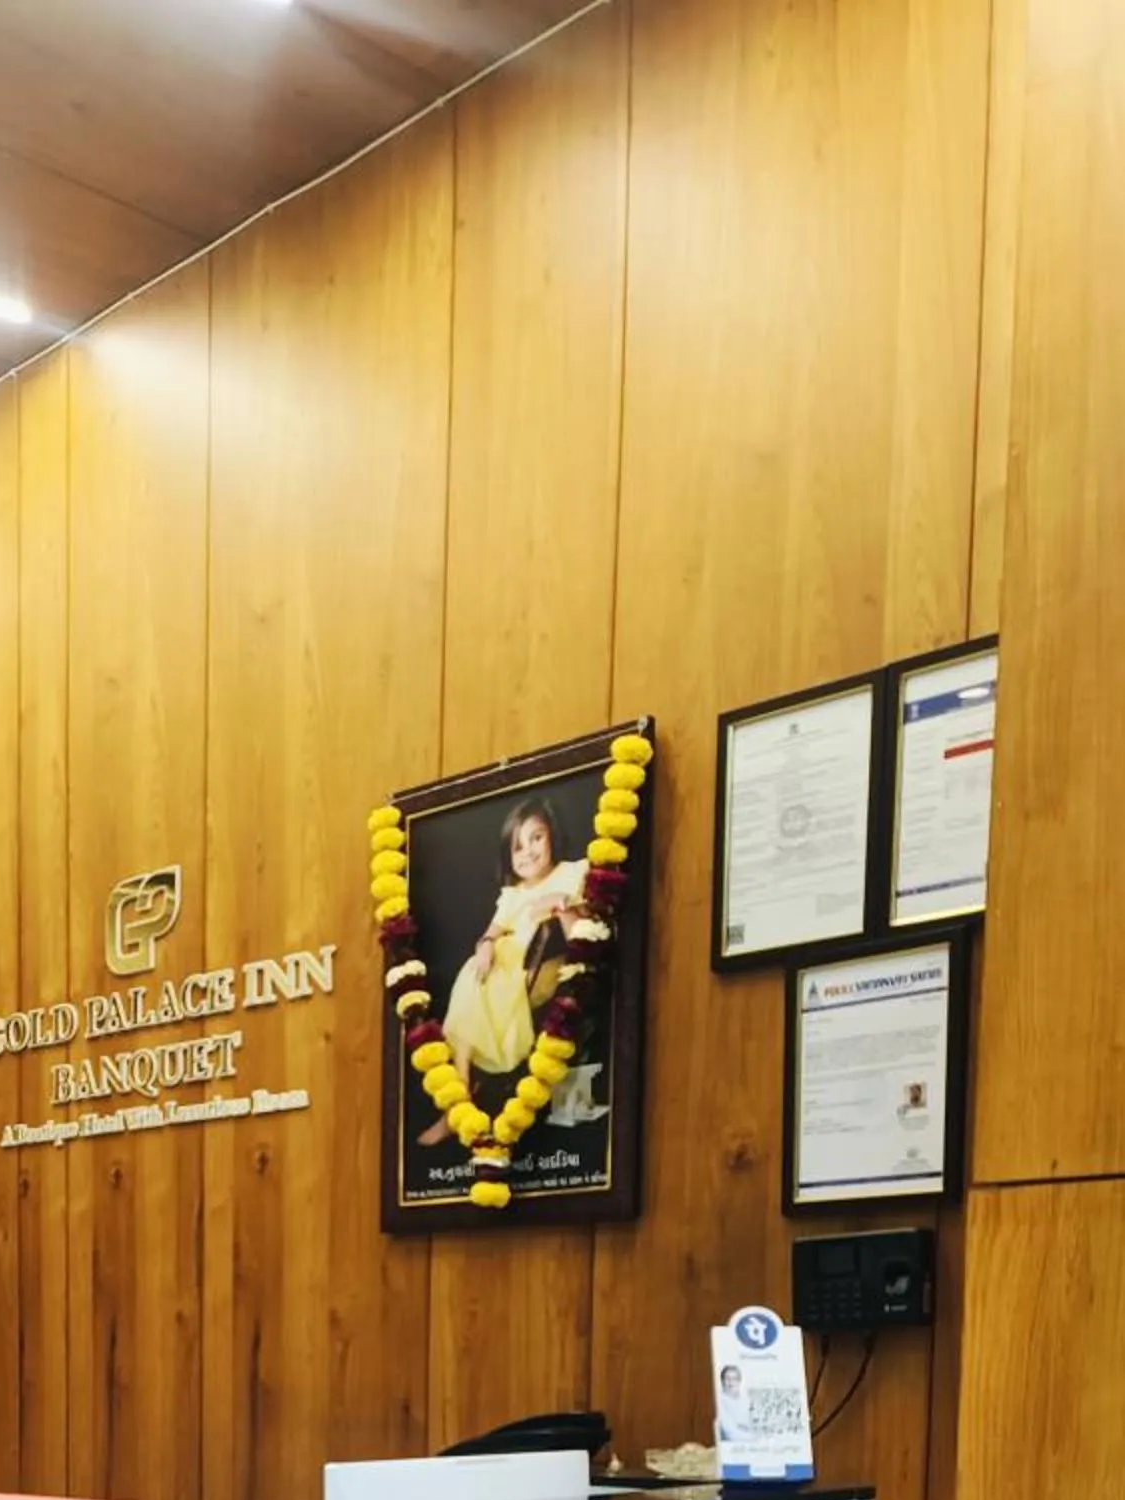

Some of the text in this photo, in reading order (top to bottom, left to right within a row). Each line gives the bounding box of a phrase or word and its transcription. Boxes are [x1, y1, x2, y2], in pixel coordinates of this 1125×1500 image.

[85, 968, 236, 1040] PALACE
[242, 943, 337, 1008] INN
[51, 1030, 243, 1104] BANQUET
